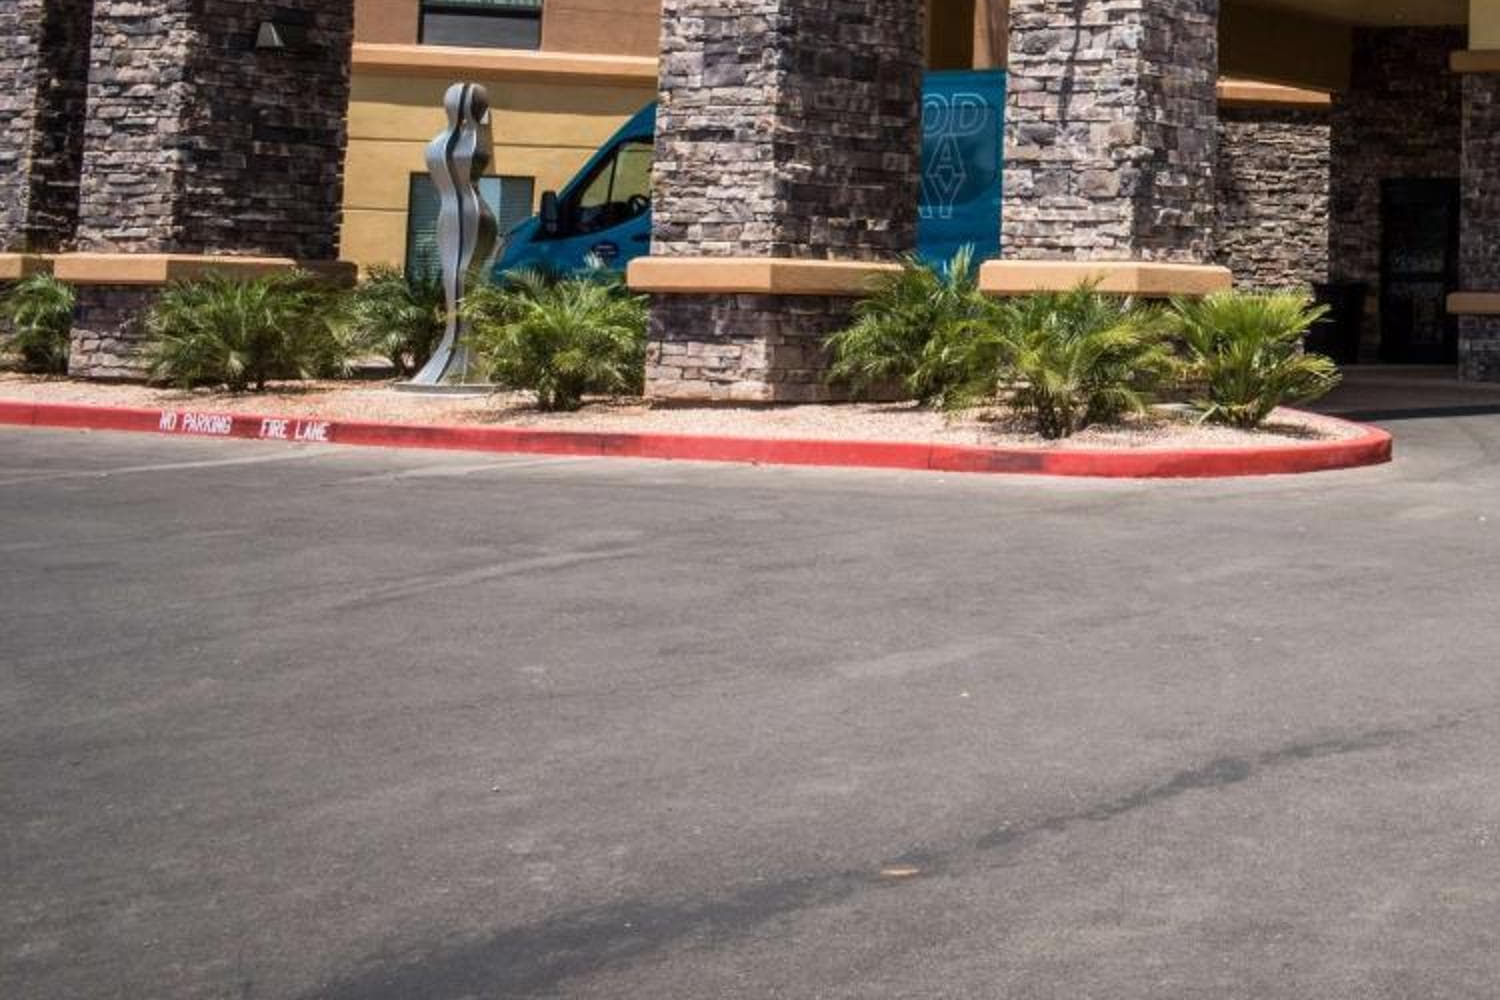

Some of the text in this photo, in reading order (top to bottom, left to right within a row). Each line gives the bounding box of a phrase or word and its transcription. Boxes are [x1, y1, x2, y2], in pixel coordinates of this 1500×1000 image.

[160, 411, 330, 441] NO PARKING FIRE LANE
